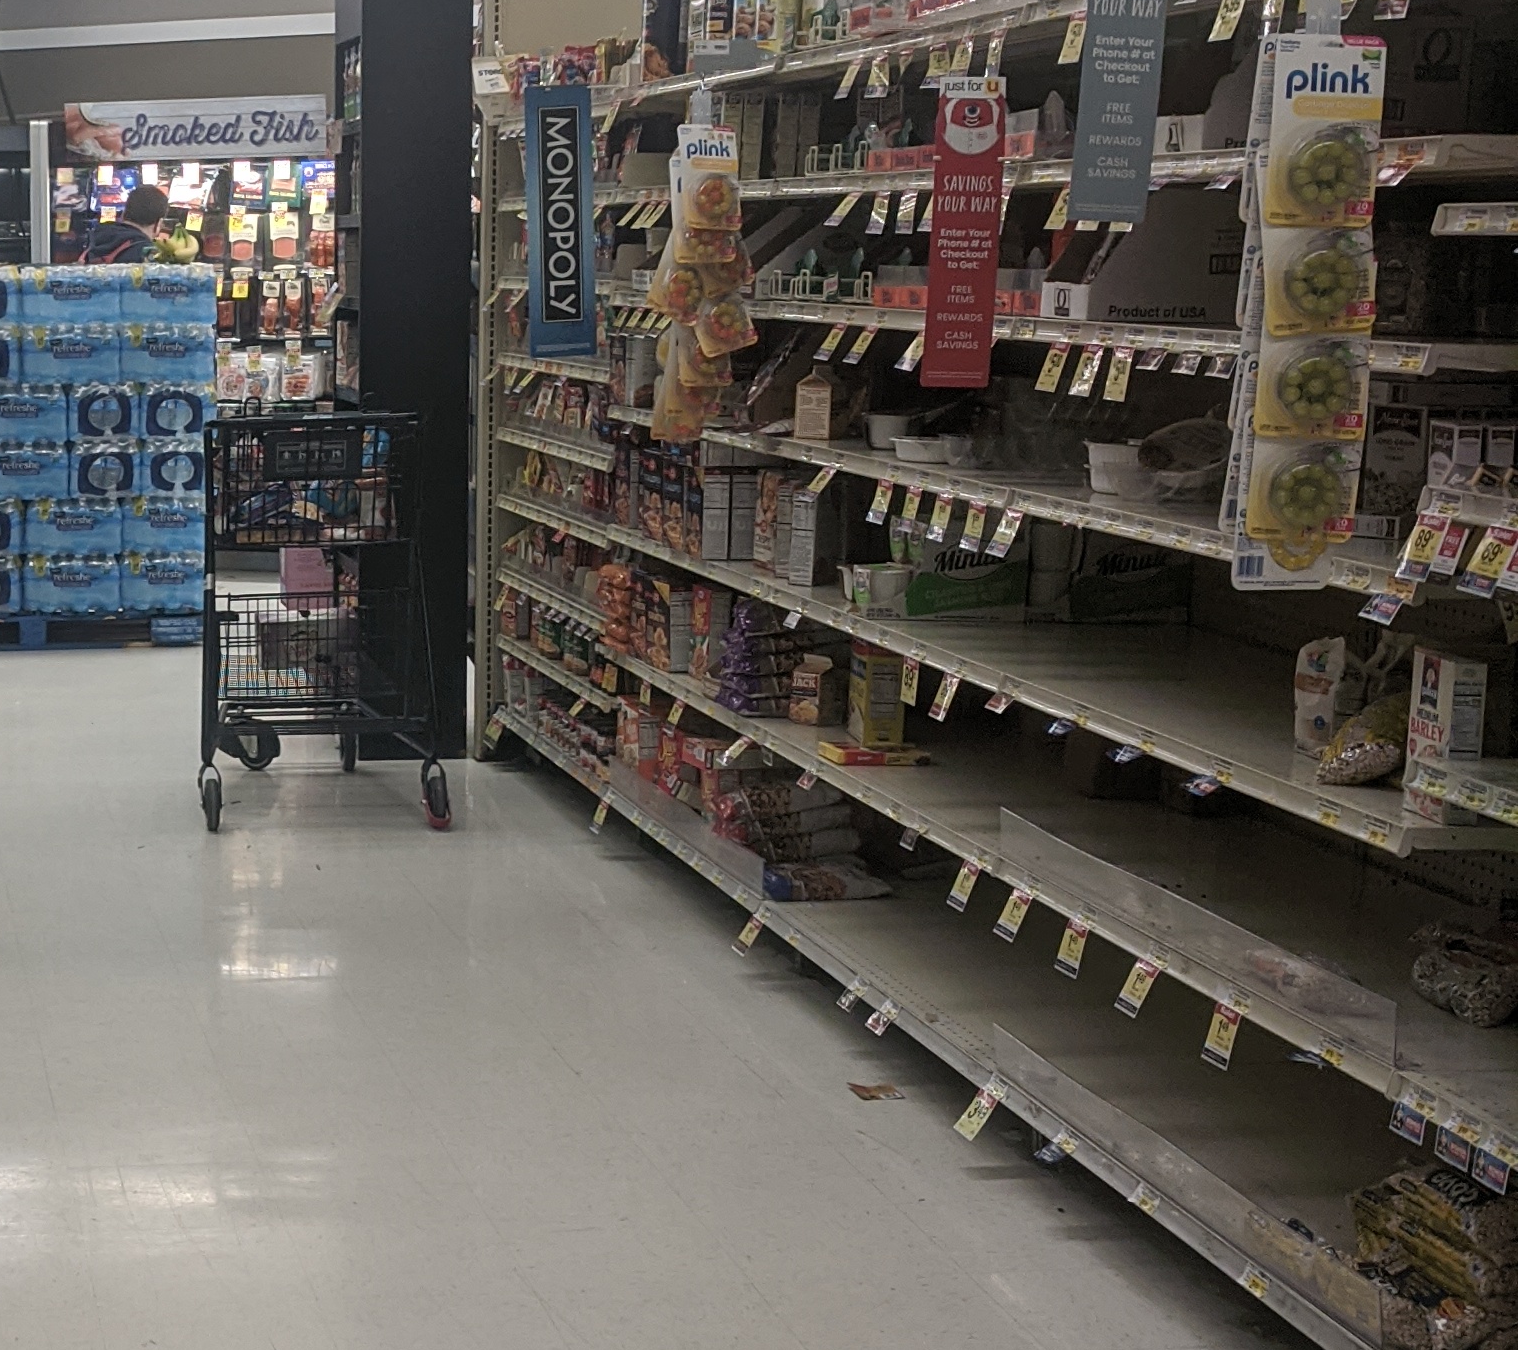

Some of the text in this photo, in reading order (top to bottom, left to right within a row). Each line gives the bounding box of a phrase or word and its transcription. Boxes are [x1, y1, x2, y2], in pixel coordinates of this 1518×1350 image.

[1095, 35, 1155, 47] Enter Your
[1092, 47, 1155, 60] Phone # at
[1095, 61, 1150, 72] Checkout
[1103, 73, 1113, 83] to
[1285, 62, 1371, 99] plink
[945, 81, 965, 93] just
[968, 79, 984, 91] for
[1106, 102, 1131, 113] FREE
[1102, 114, 1133, 124] ITEMS
[122, 110, 319, 150] Smoked Fish
[1089, 135, 1142, 146] REWARDS
[686, 139, 731, 159] plink
[1097, 157, 1129, 167] CASH
[1087, 168, 1136, 179] SAVINGS
[943, 175, 994, 191] SAVINGS
[937, 195, 998, 212] YOUR WAY
[545, 116, 577, 315] MONOPOLY
[941, 228, 991, 237] Enter Your
[938, 239, 968, 248] Phone
[982, 240, 992, 248] at
[940, 250, 988, 259] Checkout
[947, 261, 958, 269] to
[951, 285, 972, 294] FREE
[947, 295, 975, 303] ITEMS
[1108, 305, 1206, 318] Product of USA
[937, 313, 983, 322] REWARDS
[945, 331, 972, 340] CASH
[936, 341, 979, 349] SAVINGS
[792, 676, 816, 688] JACK
[1410, 717, 1445, 743] BARLEY
